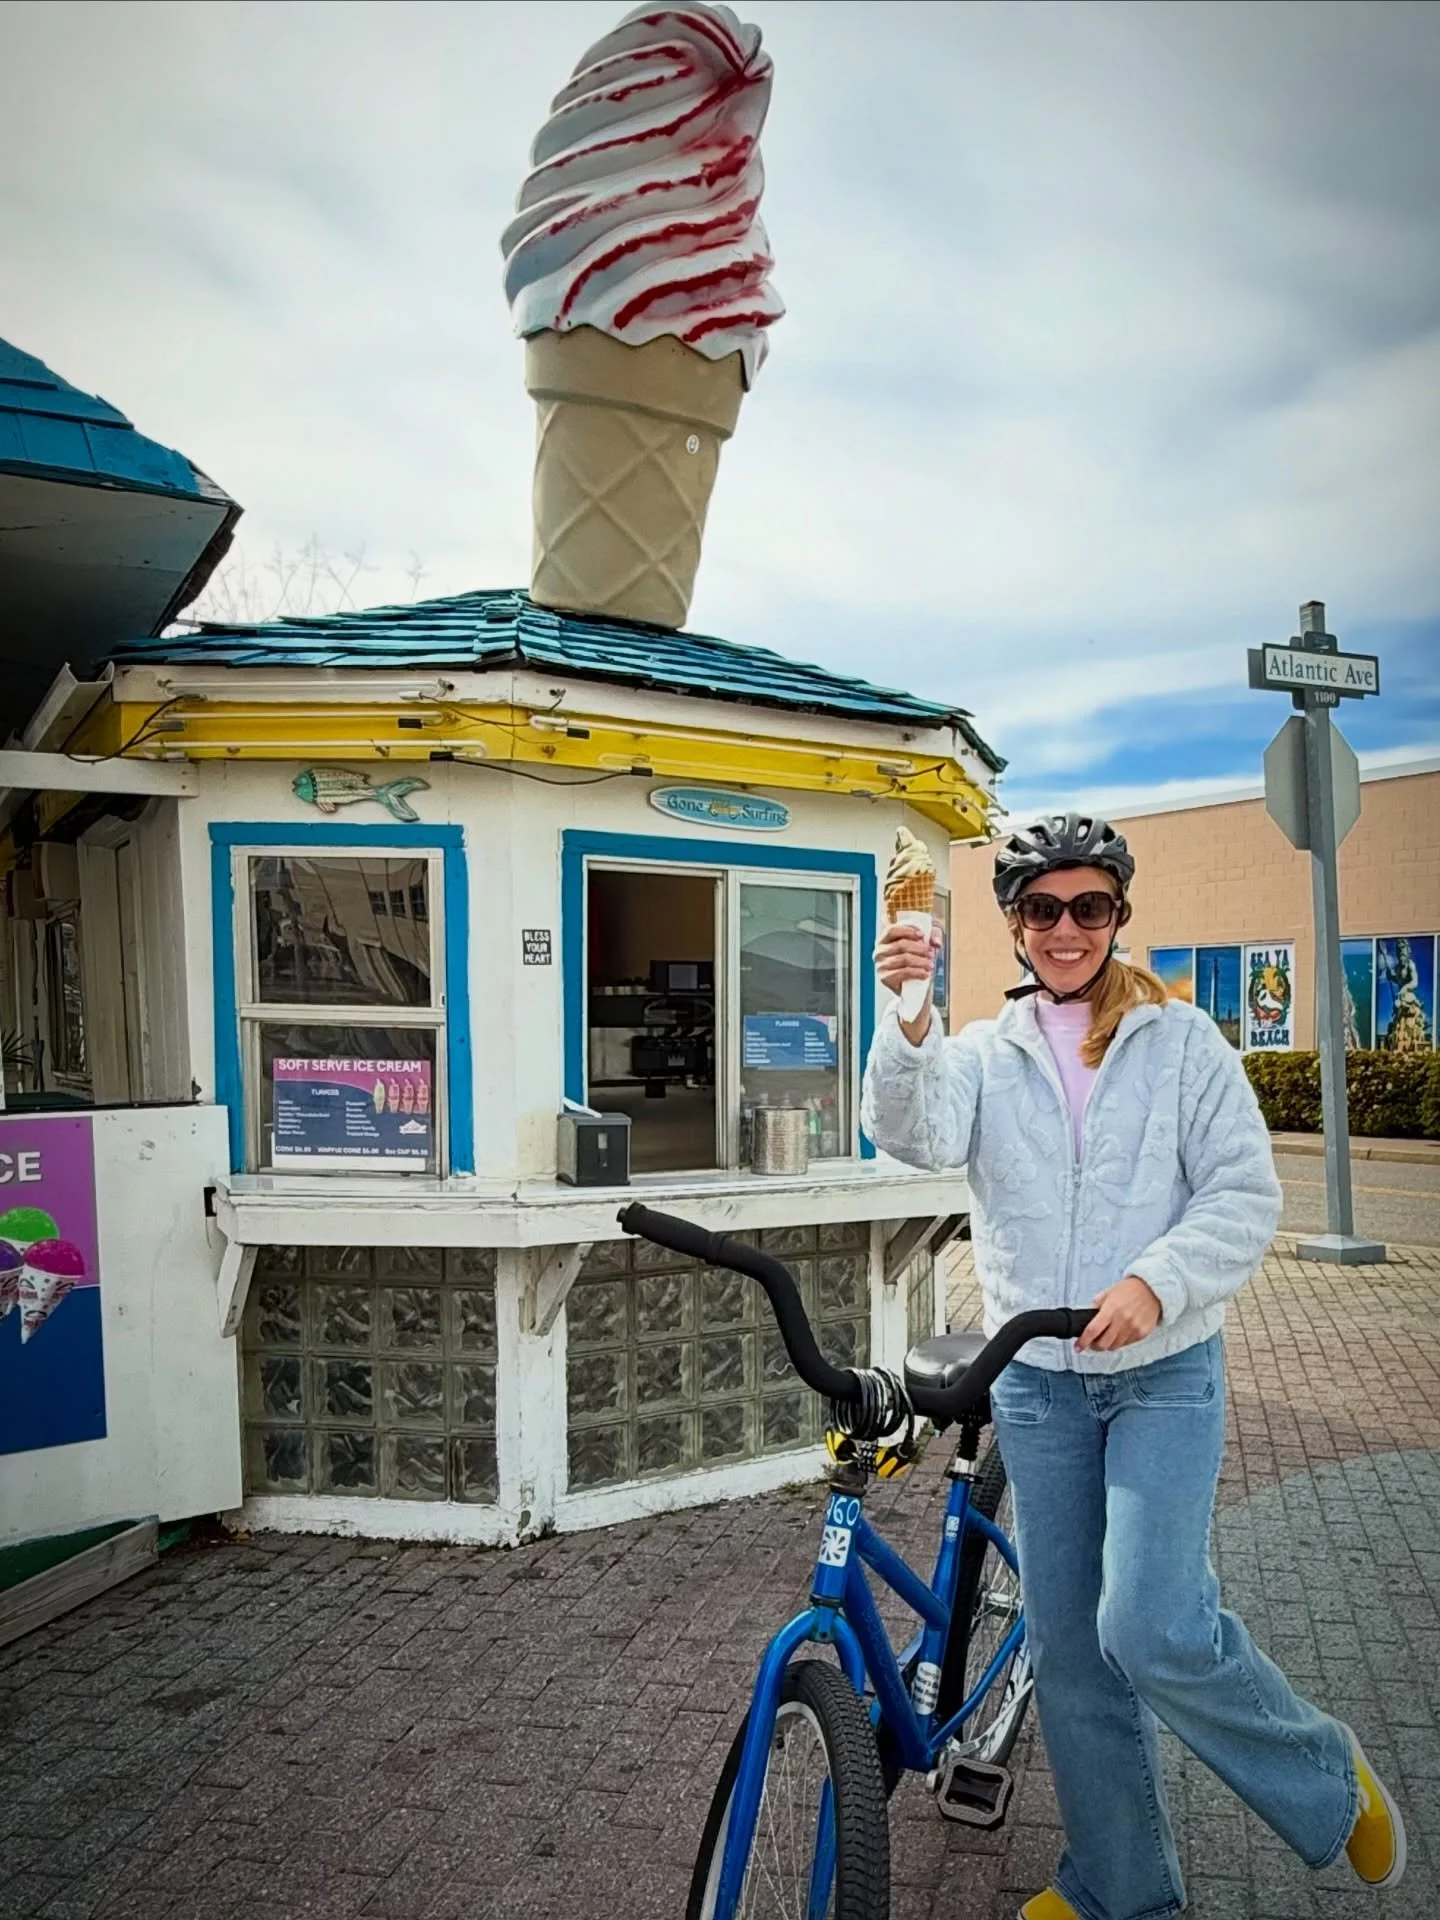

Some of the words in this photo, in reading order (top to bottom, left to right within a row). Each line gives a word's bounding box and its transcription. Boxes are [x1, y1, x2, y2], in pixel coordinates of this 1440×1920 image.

[1268, 654, 1337, 682] Atlantic
[1344, 663, 1373, 686] Ave
[666, 794, 703, 812] Gone
[741, 804, 789, 825] Surfing
[524, 931, 550, 942] BLESS
[526, 942, 548, 953] YOUR
[524, 953, 551, 964] HEART
[1274, 949, 1290, 967] YA
[1250, 1029, 1290, 1047] BEACH
[278, 1059, 309, 1071] SOFT
[312, 1060, 351, 1071] SERVE
[353, 1060, 374, 1072] ICE
[376, 1061, 422, 1073] CREAM
